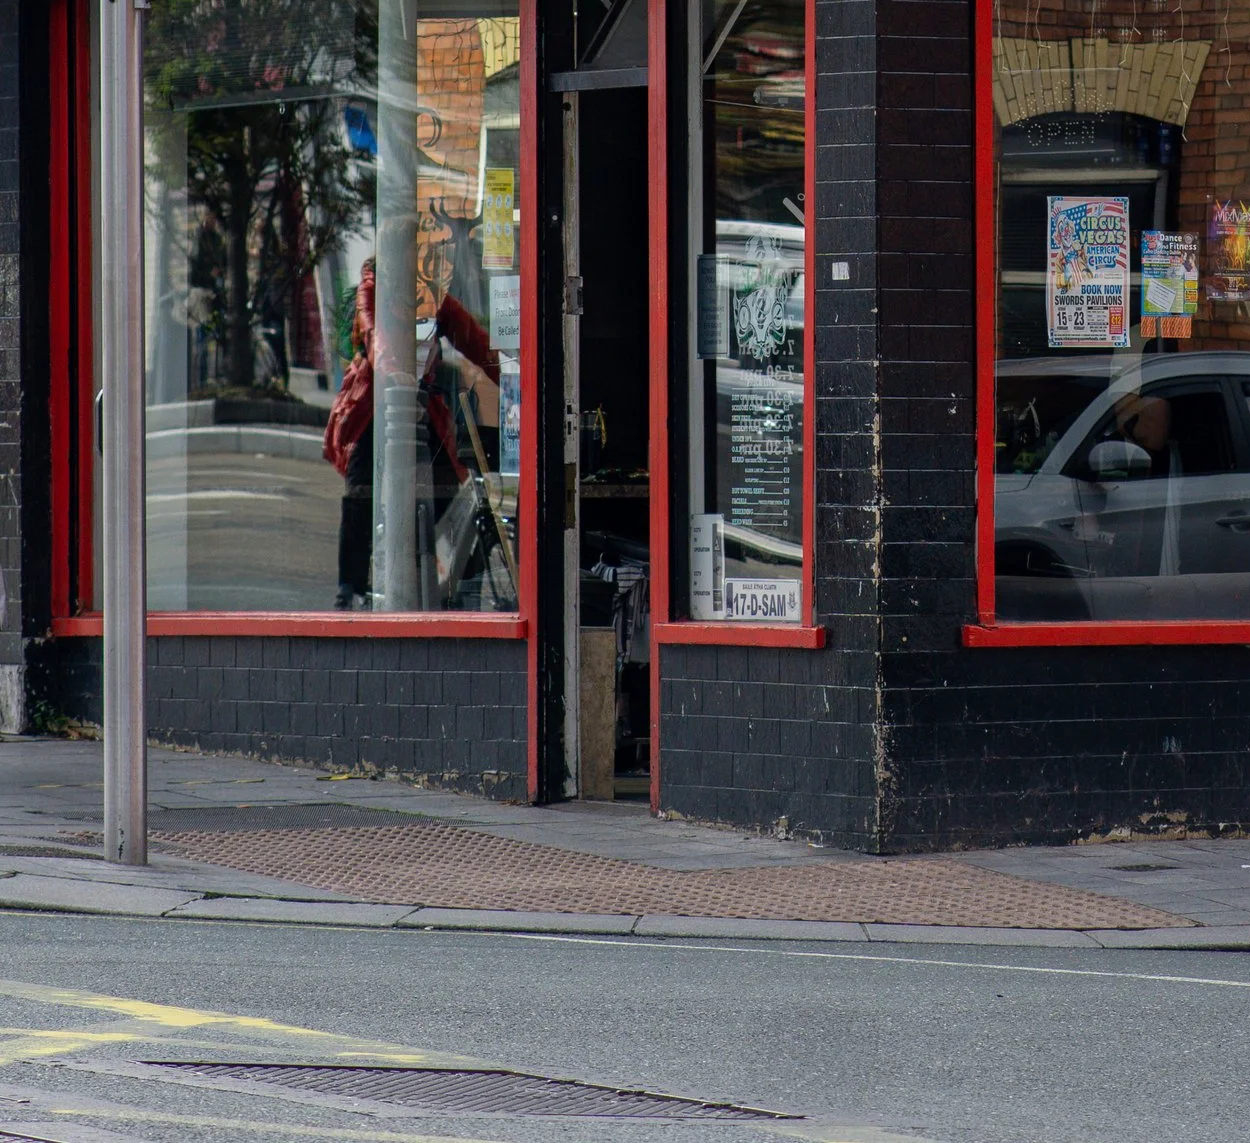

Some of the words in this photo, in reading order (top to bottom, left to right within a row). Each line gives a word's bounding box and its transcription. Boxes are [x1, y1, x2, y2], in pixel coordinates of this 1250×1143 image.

[1027, 121, 1096, 147] OPEN
[1080, 216, 1122, 230] CIRCUS
[1160, 233, 1183, 242] Dance
[1086, 246, 1120, 255] AMERICAN
[1169, 242, 1197, 251] Fitness
[1088, 256, 1117, 267] CIRCUS
[1081, 284, 1102, 295] BOOK
[1104, 284, 1122, 295] NOW
[1054, 295, 1085, 306] SWORDS
[1086, 295, 1123, 306] PAVILIONS
[1057, 311, 1067, 326] 15
[1073, 311, 1085, 326] 23
[733, 593, 787, 617] 17-D-SAM
